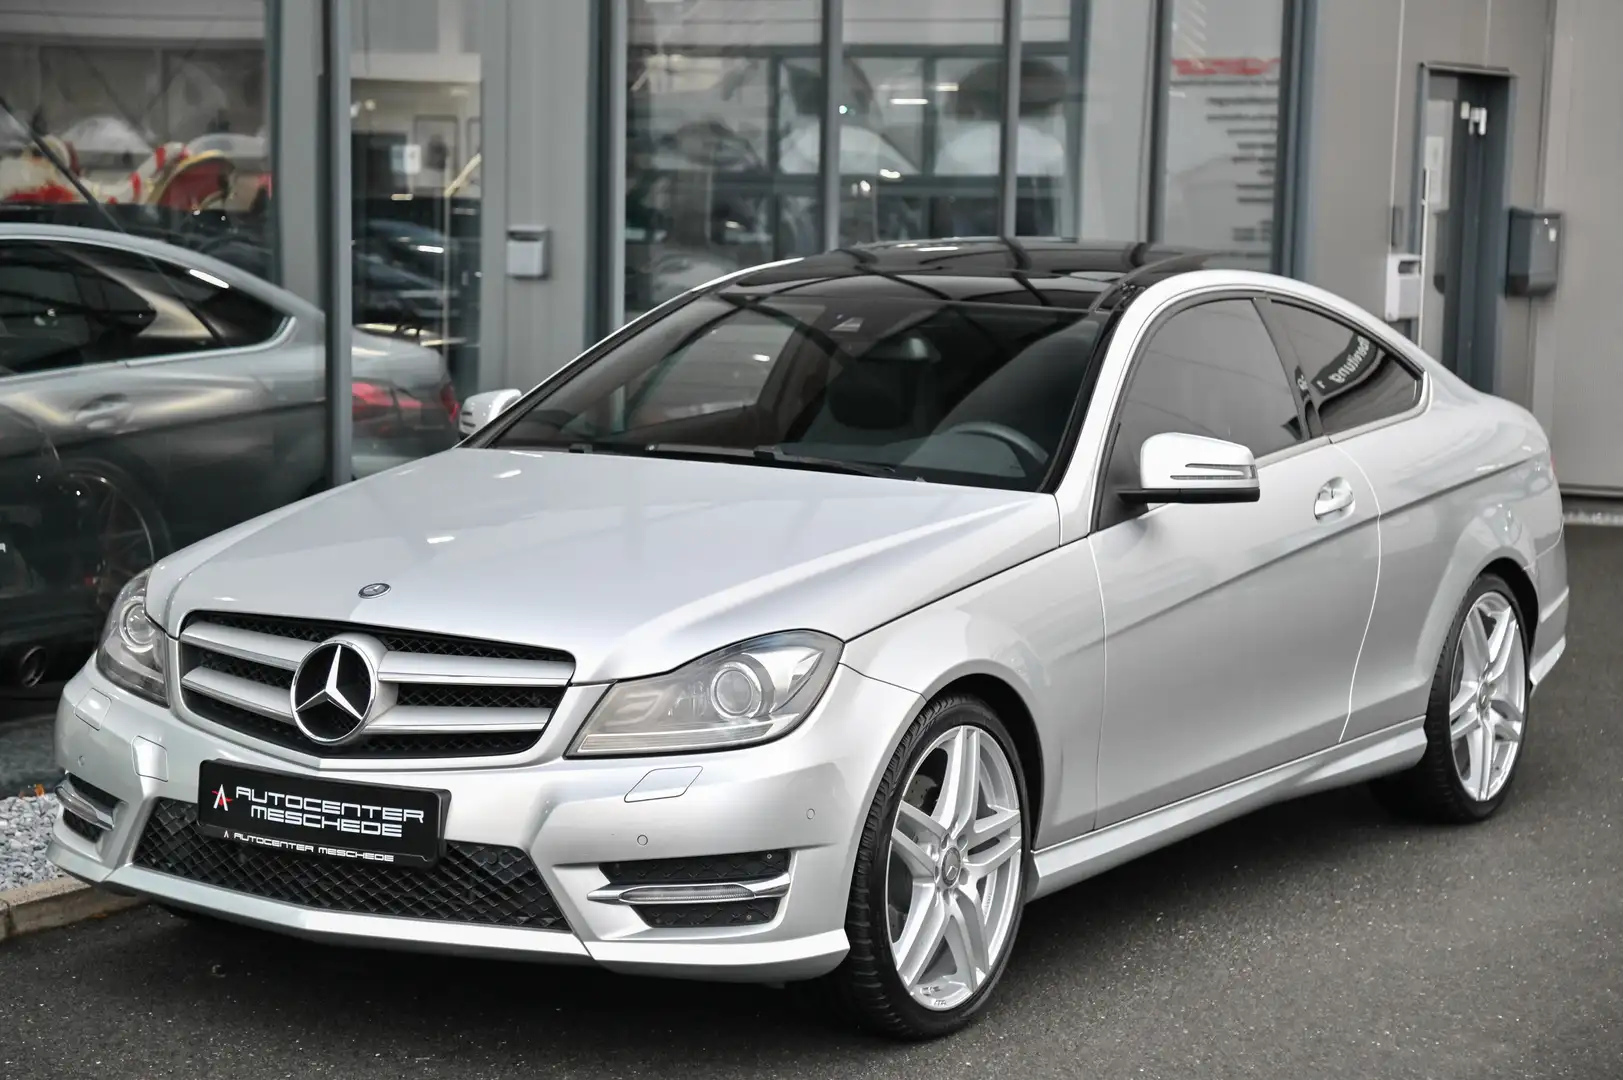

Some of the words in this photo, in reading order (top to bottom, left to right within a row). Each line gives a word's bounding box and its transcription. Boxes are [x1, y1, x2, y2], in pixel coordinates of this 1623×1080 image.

[236, 786, 424, 823] AUTOCENTER
[251, 805, 402, 838] MESCHEDE
[233, 832, 314, 853] AUTOCENTER
[318, 847, 394, 862] MESCHEDE
